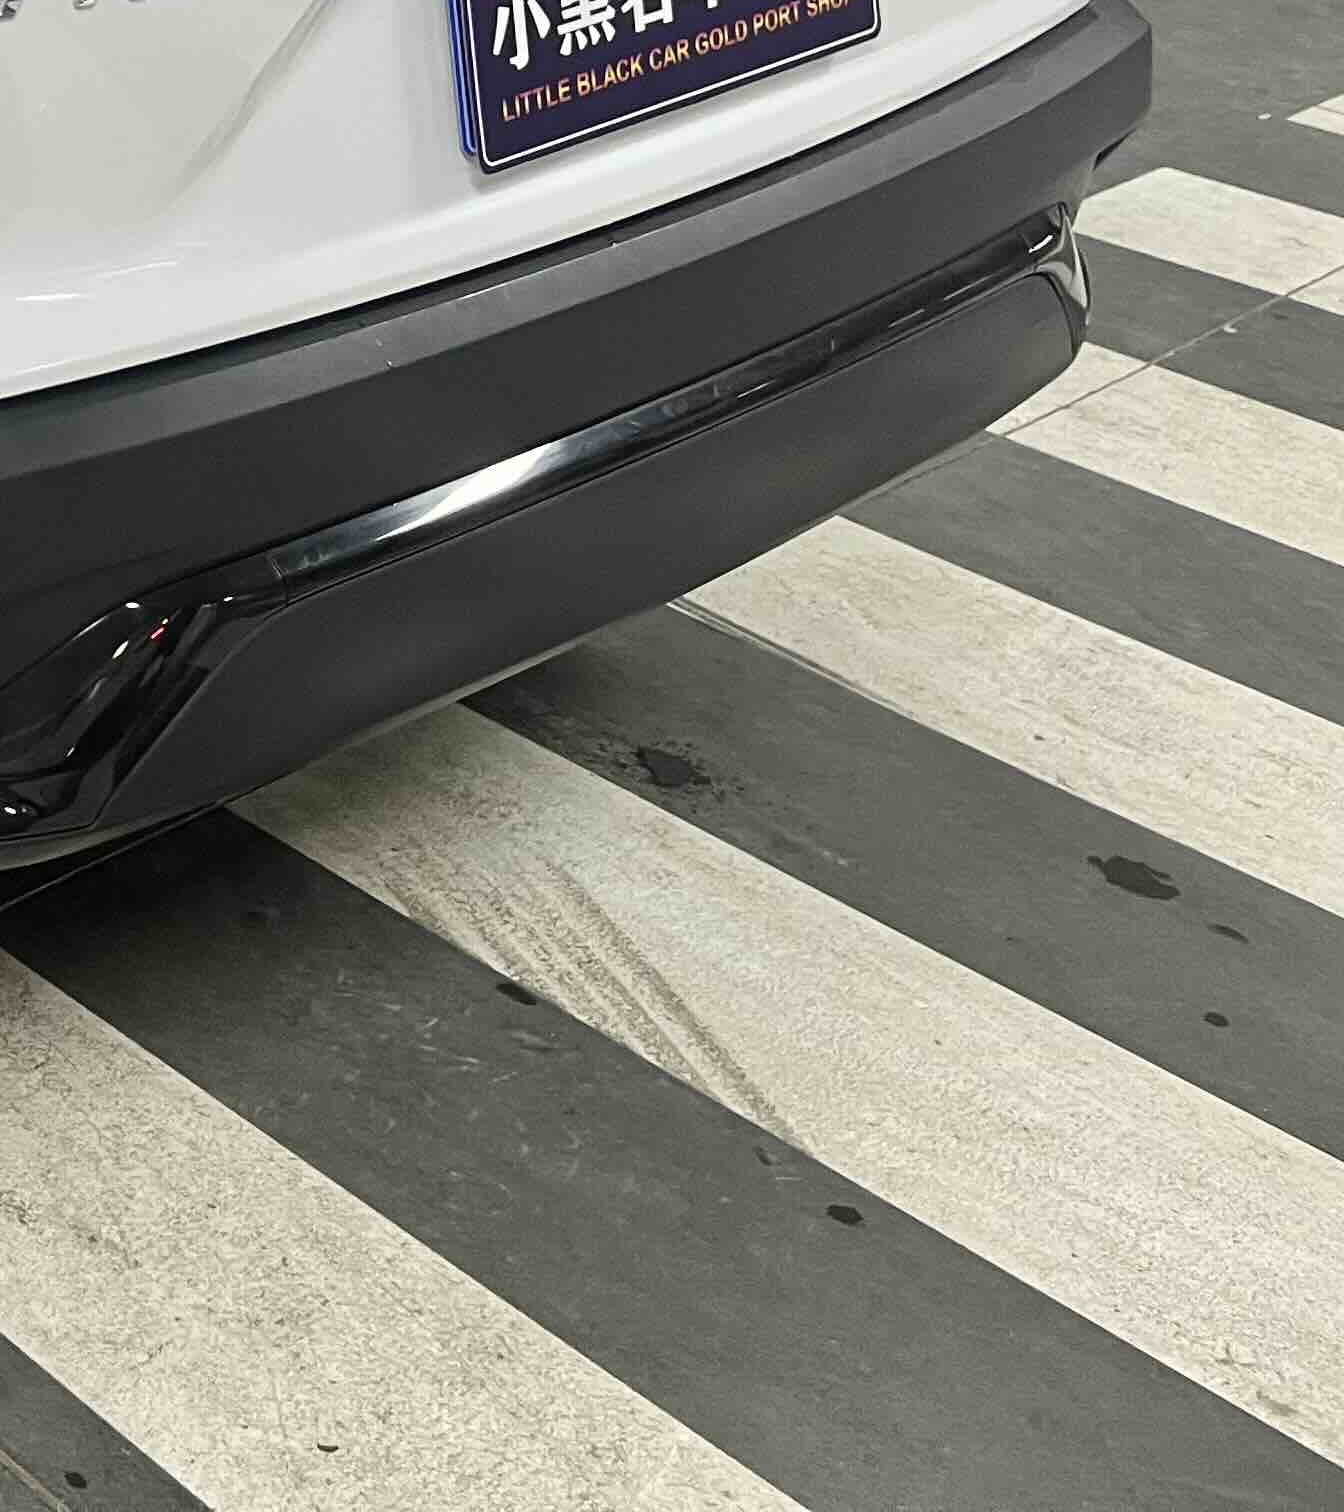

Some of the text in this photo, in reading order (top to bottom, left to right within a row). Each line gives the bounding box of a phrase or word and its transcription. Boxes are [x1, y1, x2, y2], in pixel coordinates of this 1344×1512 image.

[502, 78, 572, 121] LITTLE
[576, 58, 645, 97] BLACK
[649, 38, 690, 71] CAR
[695, 19, 748, 55] GOLD
[753, 0, 803, 36] PORT
